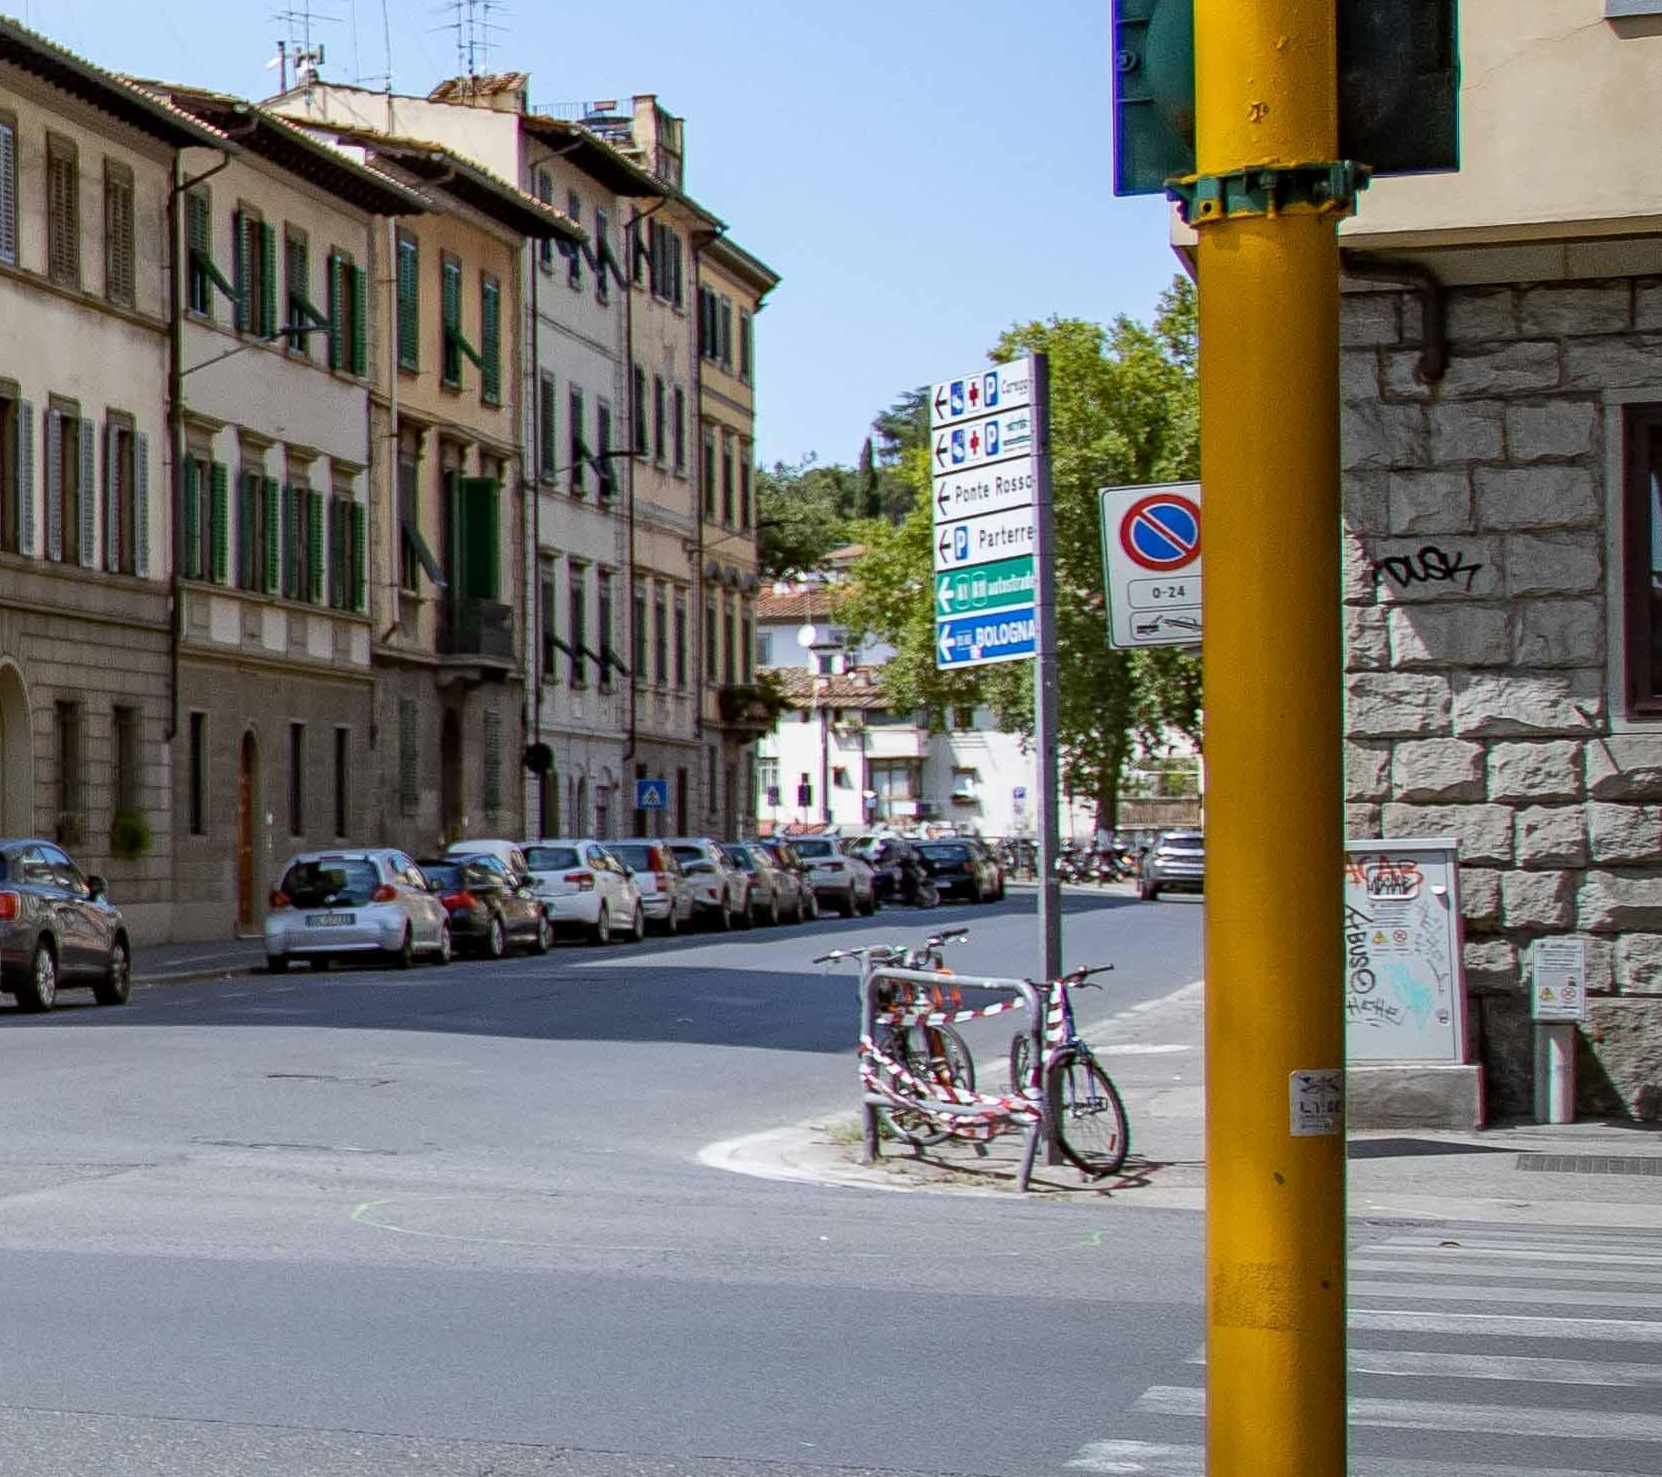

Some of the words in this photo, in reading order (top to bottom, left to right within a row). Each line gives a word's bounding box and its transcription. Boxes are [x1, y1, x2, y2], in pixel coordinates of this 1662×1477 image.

[956, 482, 990, 504] Ponte
[995, 474, 1034, 496] Rosso
[979, 524, 1035, 549] Parterre
[1151, 585, 1186, 599] 0-24
[975, 619, 1036, 647] BOLOGNA
